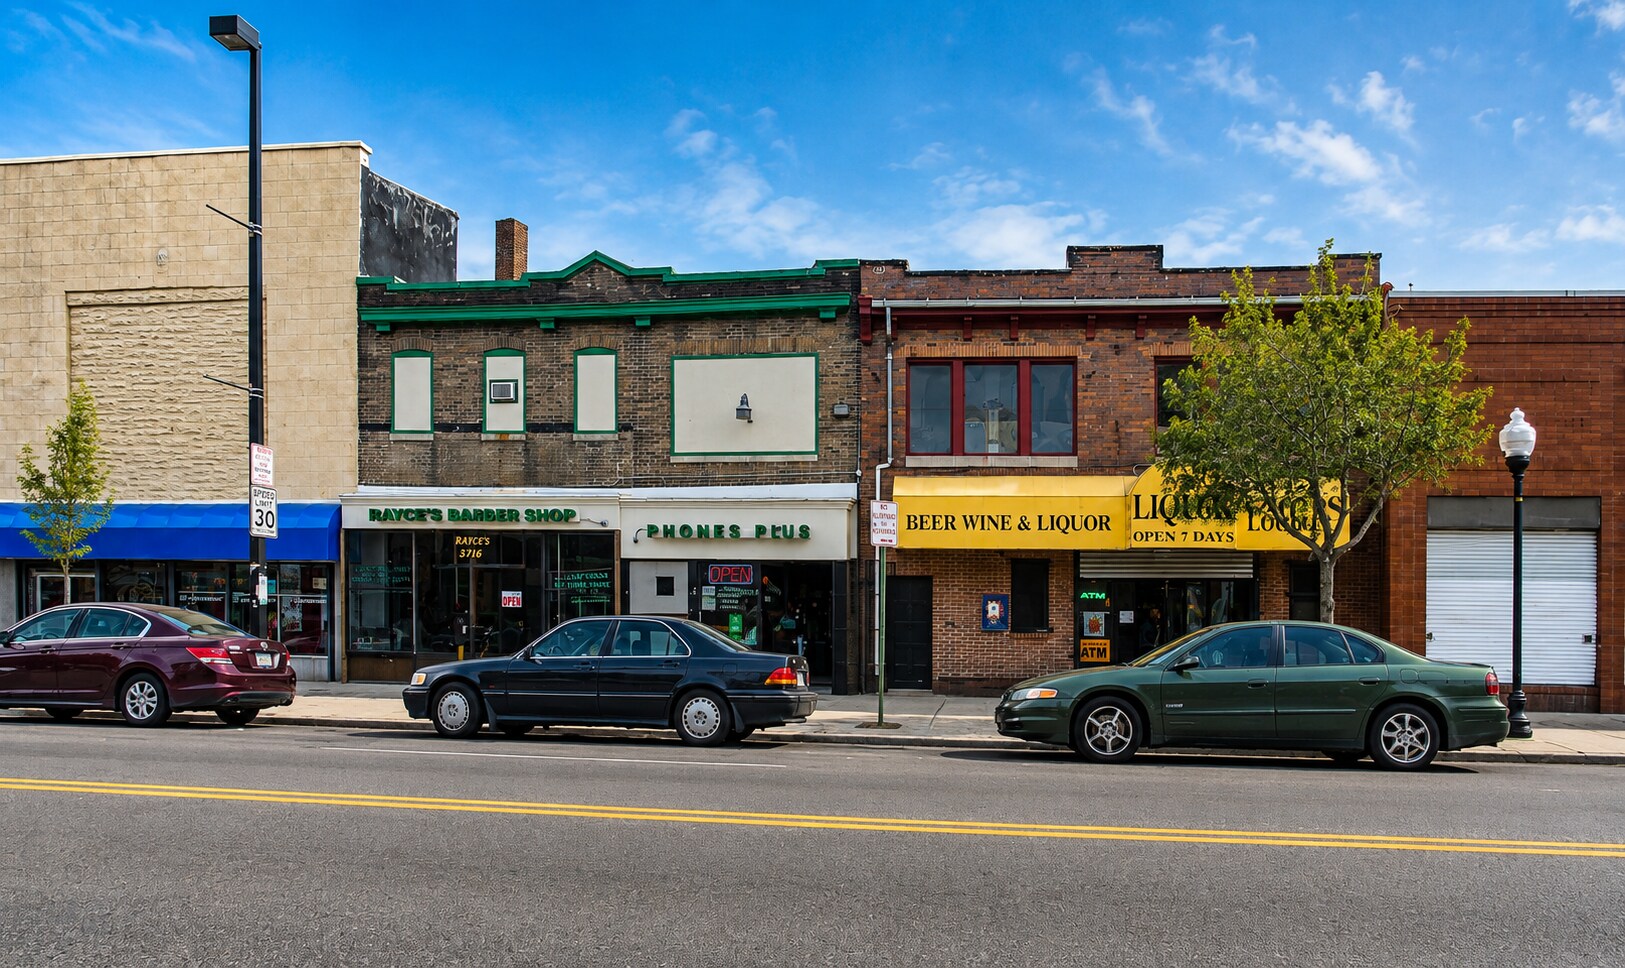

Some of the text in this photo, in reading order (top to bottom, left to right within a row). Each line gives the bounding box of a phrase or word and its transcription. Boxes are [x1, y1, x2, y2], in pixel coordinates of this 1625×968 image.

[254, 508, 275, 529] 30
[368, 508, 577, 523] RAYCE'S BARBER SHOP
[906, 514, 957, 531] BEER
[961, 514, 1012, 531] WINE
[1017, 515, 1031, 531] &
[1037, 514, 1111, 535] LIQUOR
[647, 524, 811, 539] PHONES PLUS
[1133, 531, 1234, 543] OPEN 7 DAYS
[455, 536, 490, 546] RAYCE'S
[710, 566, 751, 582] OPEN
[503, 596, 521, 607] OPEN
[1080, 592, 1106, 600] ATM
[1081, 647, 1107, 658] ATM
